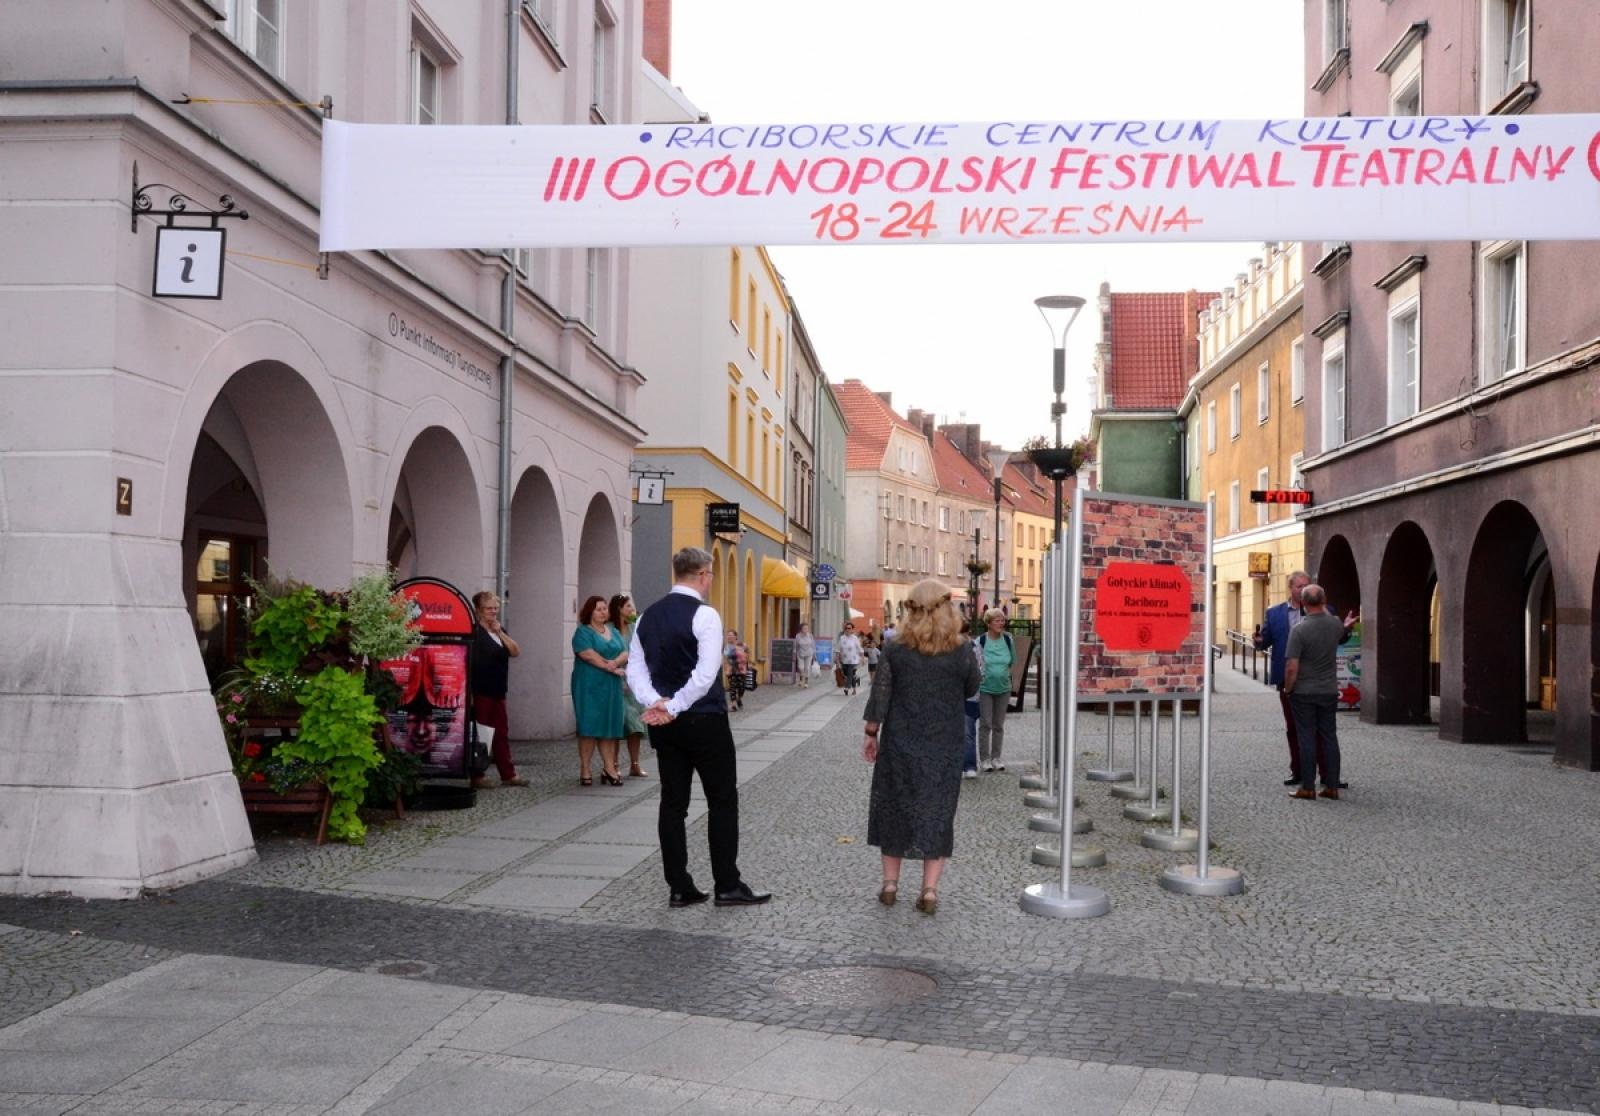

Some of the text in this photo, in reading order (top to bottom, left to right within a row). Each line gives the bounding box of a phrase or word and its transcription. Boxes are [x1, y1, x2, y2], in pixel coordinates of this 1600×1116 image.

[666, 117, 1492, 150] RACIBORSKIE CENTRUM KULTURY
[543, 156, 596, 202] III
[603, 154, 1037, 200] OGÓLNOPOLSKI
[1050, 147, 1296, 190] FESTIWAL
[1300, 144, 1576, 188] TEATRALNY
[810, 199, 1204, 242] 18-24 WRZEŚNIA
[400, 319, 422, 348] Punkt
[1266, 491, 1308, 503] FOTO
[1107, 576, 1182, 592] Gotyckie klimaty
[1124, 595, 1169, 609] Raciborza
